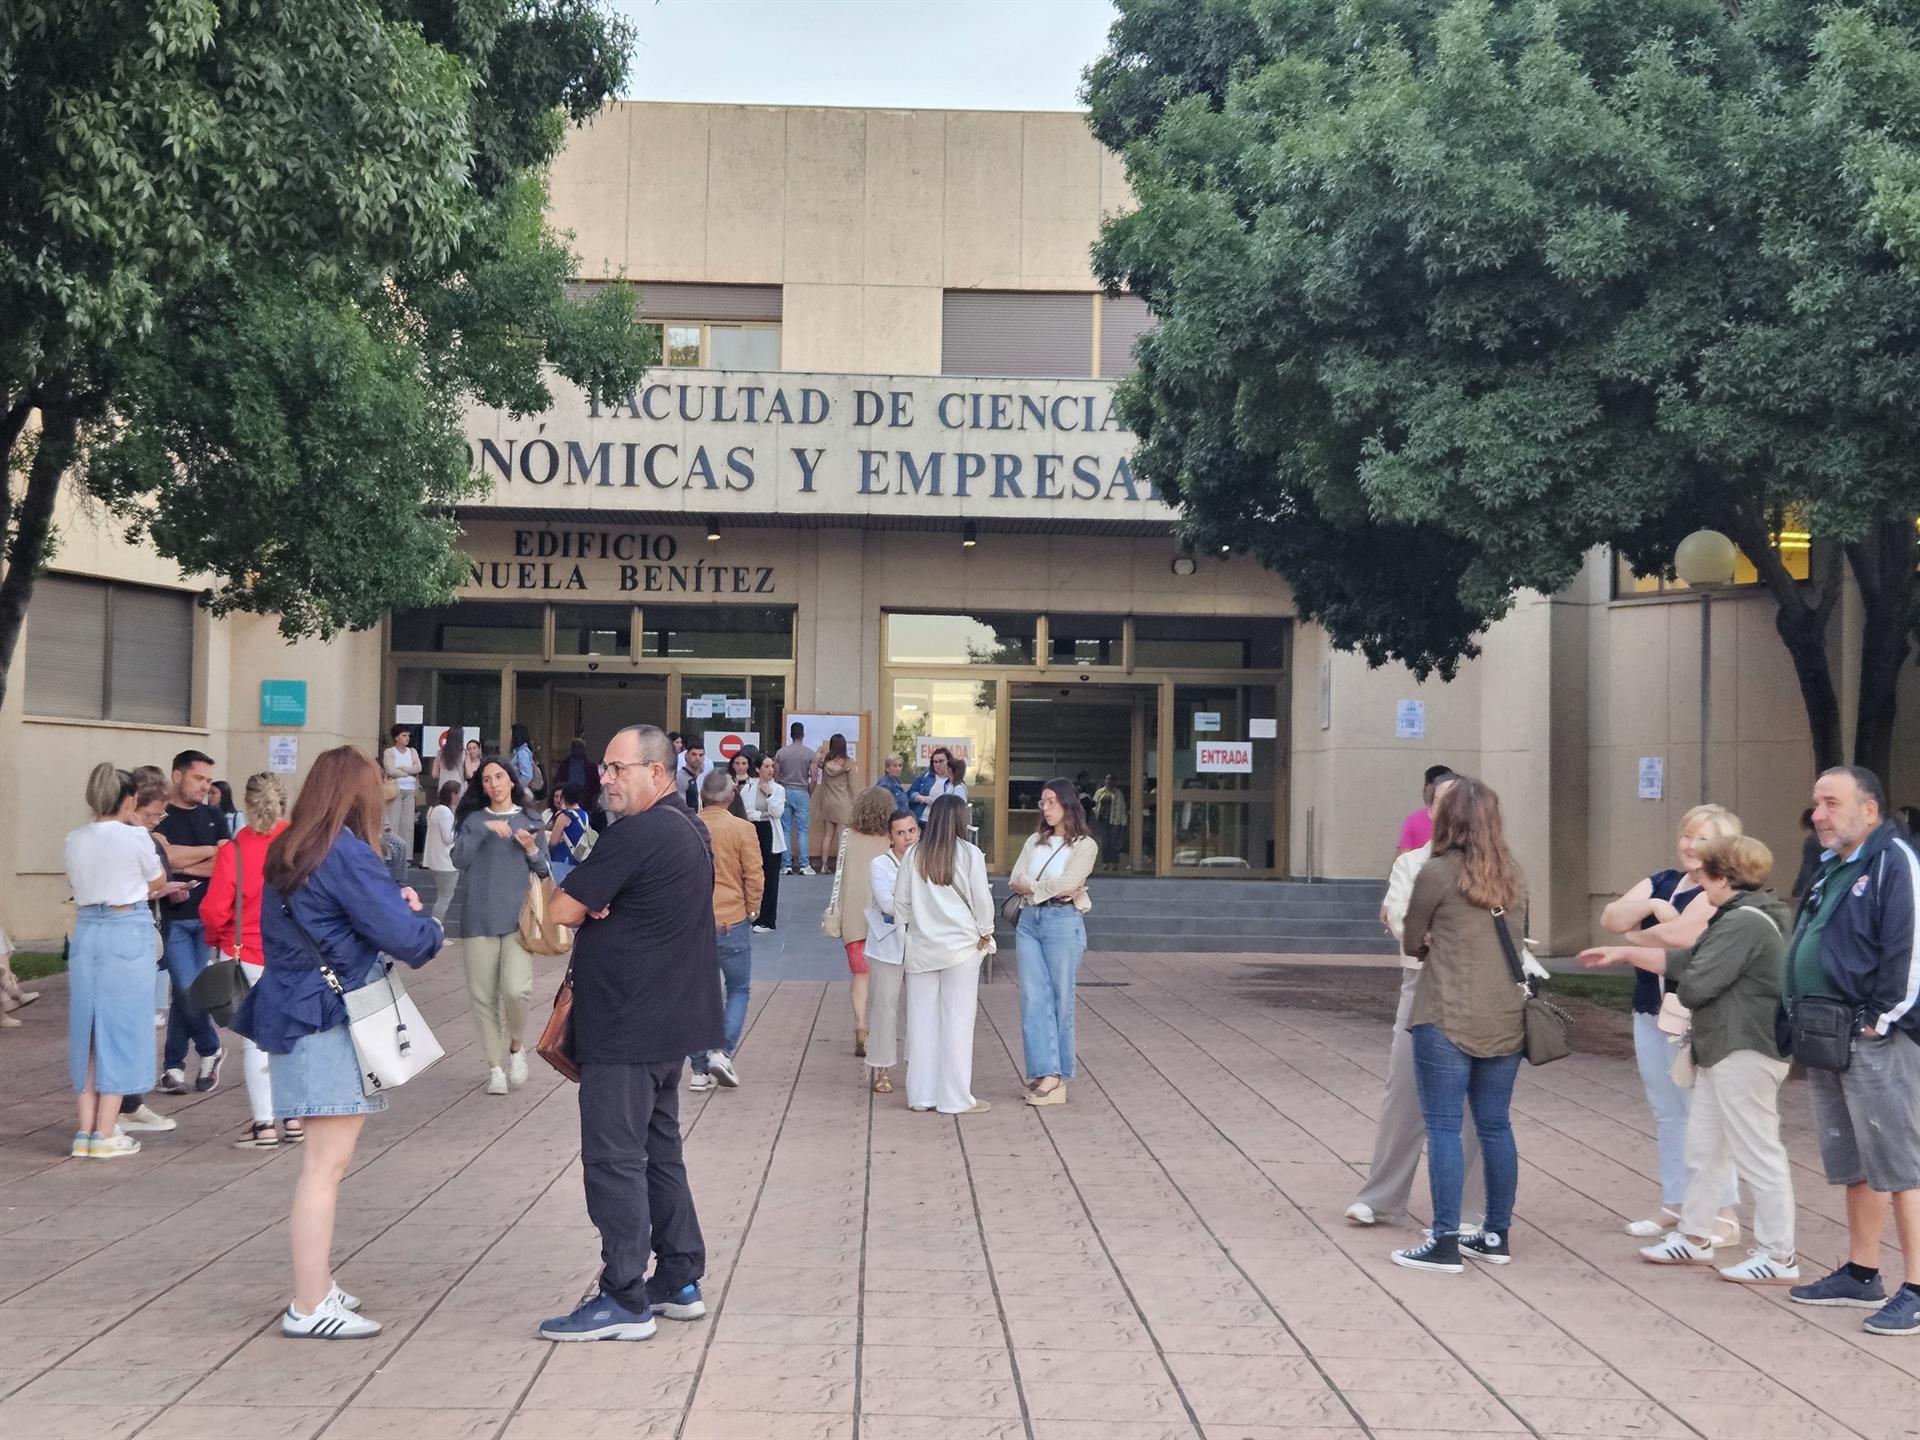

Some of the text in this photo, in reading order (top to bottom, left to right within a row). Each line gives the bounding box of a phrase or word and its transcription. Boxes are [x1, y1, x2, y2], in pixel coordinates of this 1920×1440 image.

[853, 389, 915, 428] DE
[938, 392, 1131, 432] CIENCIA
[467, 423, 756, 492] NÓMICAS
[791, 447, 826, 493] Y
[514, 530, 678, 562] EDIFICIO
[464, 559, 776, 594] NUELA BENÍTEZ
[1200, 749, 1249, 765] ENTRADA
